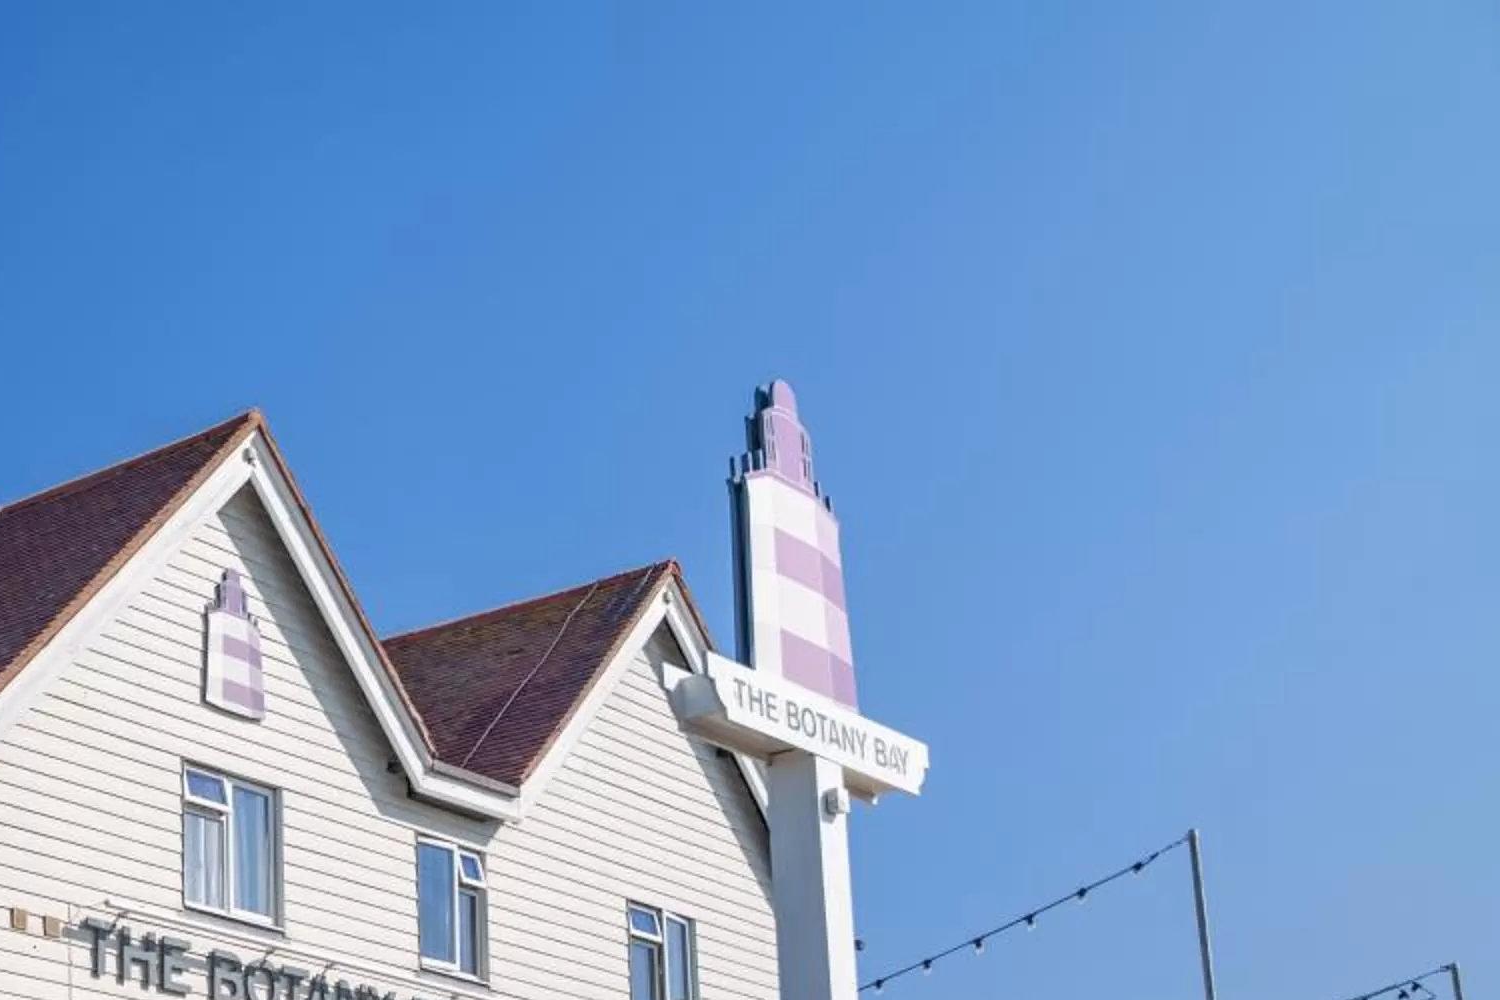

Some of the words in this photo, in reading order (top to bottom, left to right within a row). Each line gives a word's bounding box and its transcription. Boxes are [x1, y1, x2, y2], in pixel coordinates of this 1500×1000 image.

[733, 677, 779, 723] THE
[785, 701, 869, 760] BOTANY
[874, 738, 909, 776] BAY
[80, 916, 192, 997] THE
